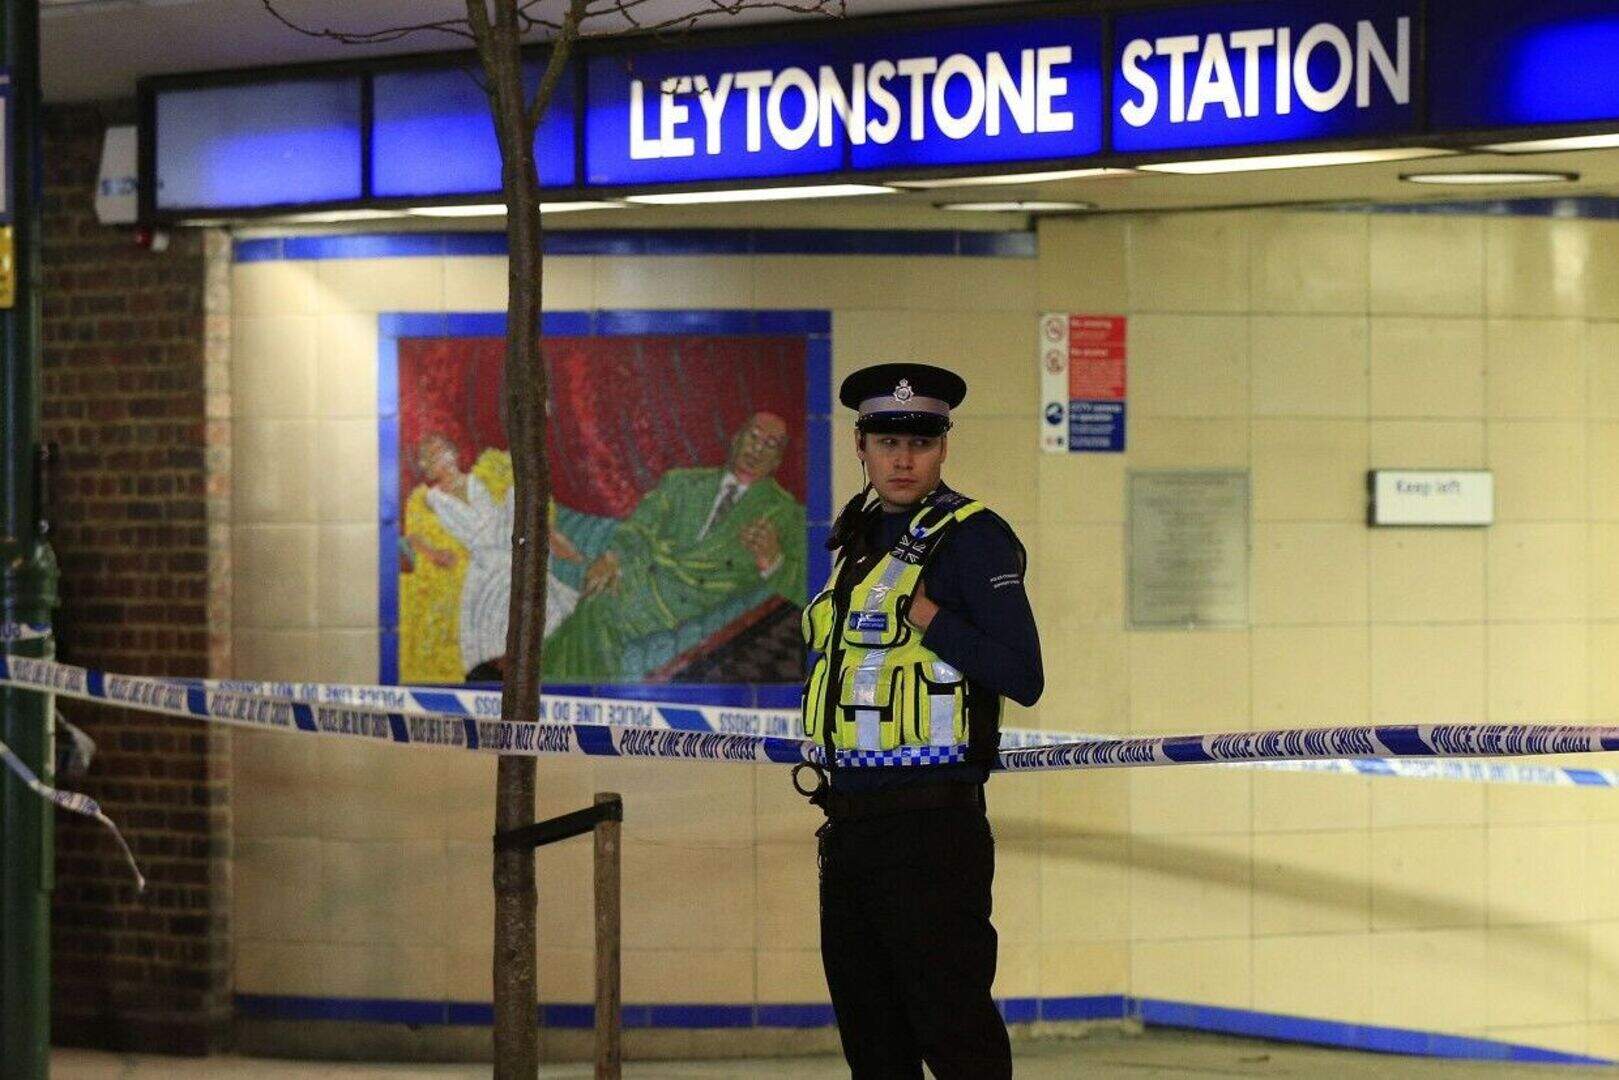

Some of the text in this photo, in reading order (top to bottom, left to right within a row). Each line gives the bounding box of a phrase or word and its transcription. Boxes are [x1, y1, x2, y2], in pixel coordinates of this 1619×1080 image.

[629, 17, 1410, 160] LEYTONSTONE STATION
[1396, 480, 1430, 497] Keep
[552, 701, 570, 720] DO
[577, 702, 603, 723] LINE
[608, 705, 652, 726] POLICE
[515, 723, 536, 751] NOT
[537, 724, 572, 752] CROSS
[619, 729, 763, 761] POLICE LINE DO NOT CROSS
[1211, 728, 1374, 758] POLICE LINE DO NOT CROSS
[1431, 725, 1477, 754] POLICE
[1476, 725, 1508, 754] LINE
[1506, 725, 1528, 754] DO
[1525, 726, 1555, 752] NOT
